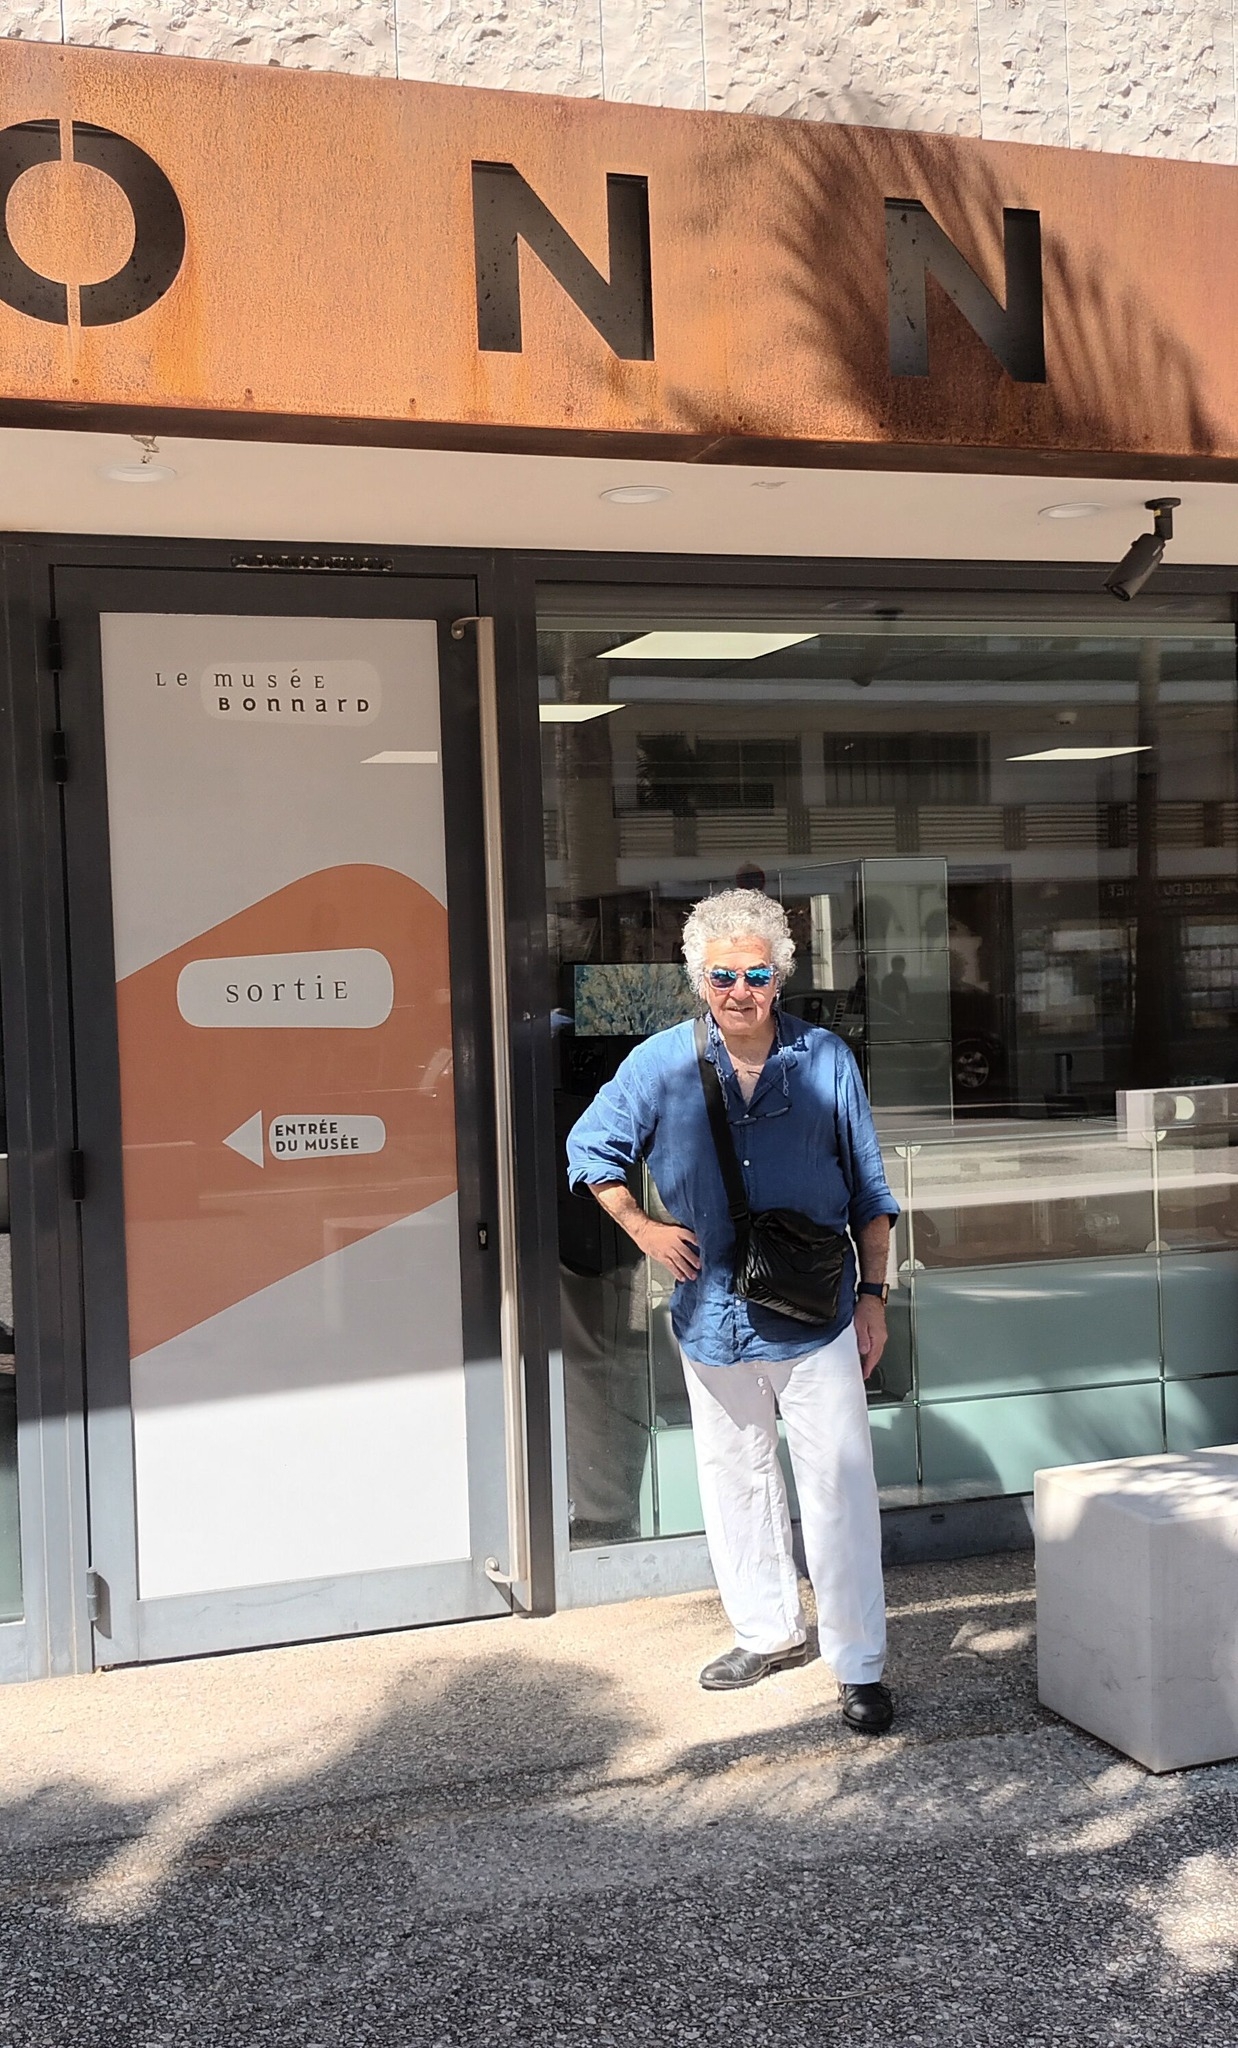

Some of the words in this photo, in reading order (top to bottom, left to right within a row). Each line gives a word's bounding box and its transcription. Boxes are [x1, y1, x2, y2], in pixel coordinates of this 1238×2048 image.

[155, 671, 188, 687] Le
[275, 1119, 338, 1137] ENTRÉE
[275, 1139, 298, 1153] DU
[305, 1134, 360, 1151] MUSÉE
